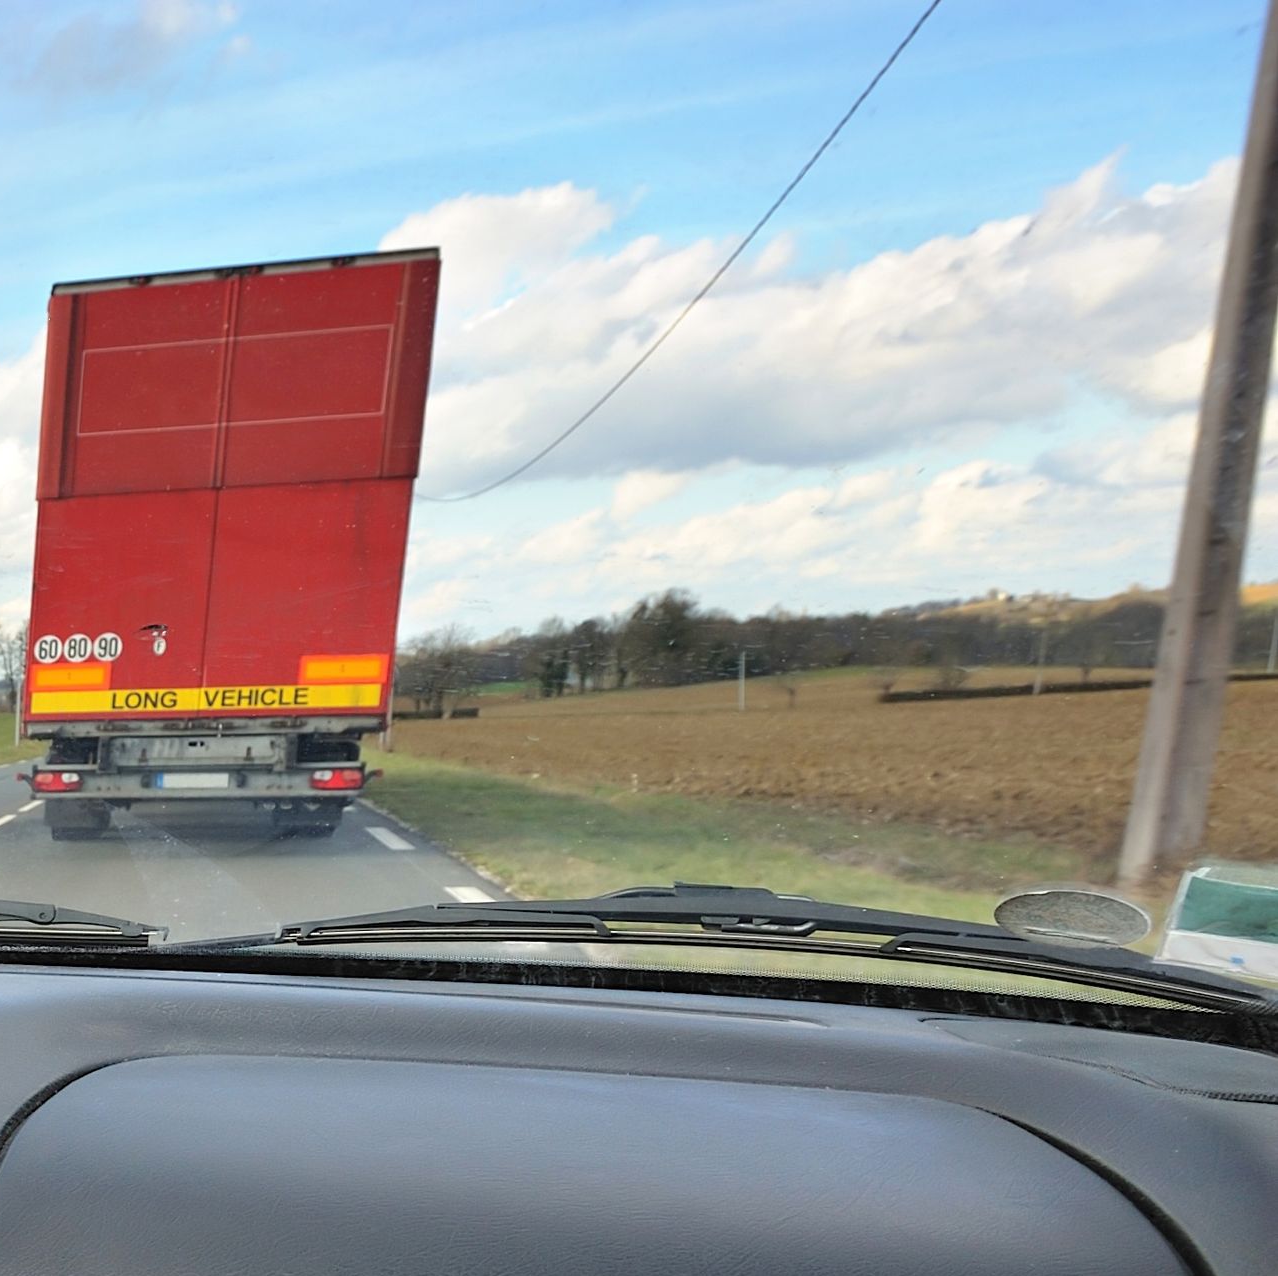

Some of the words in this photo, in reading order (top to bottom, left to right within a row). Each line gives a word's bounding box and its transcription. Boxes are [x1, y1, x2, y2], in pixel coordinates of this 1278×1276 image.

[39, 639, 59, 660] 60
[68, 638, 88, 659] 80
[98, 637, 119, 658] 90
[111, 691, 178, 710] LONG
[205, 687, 309, 707] VEHICLE
